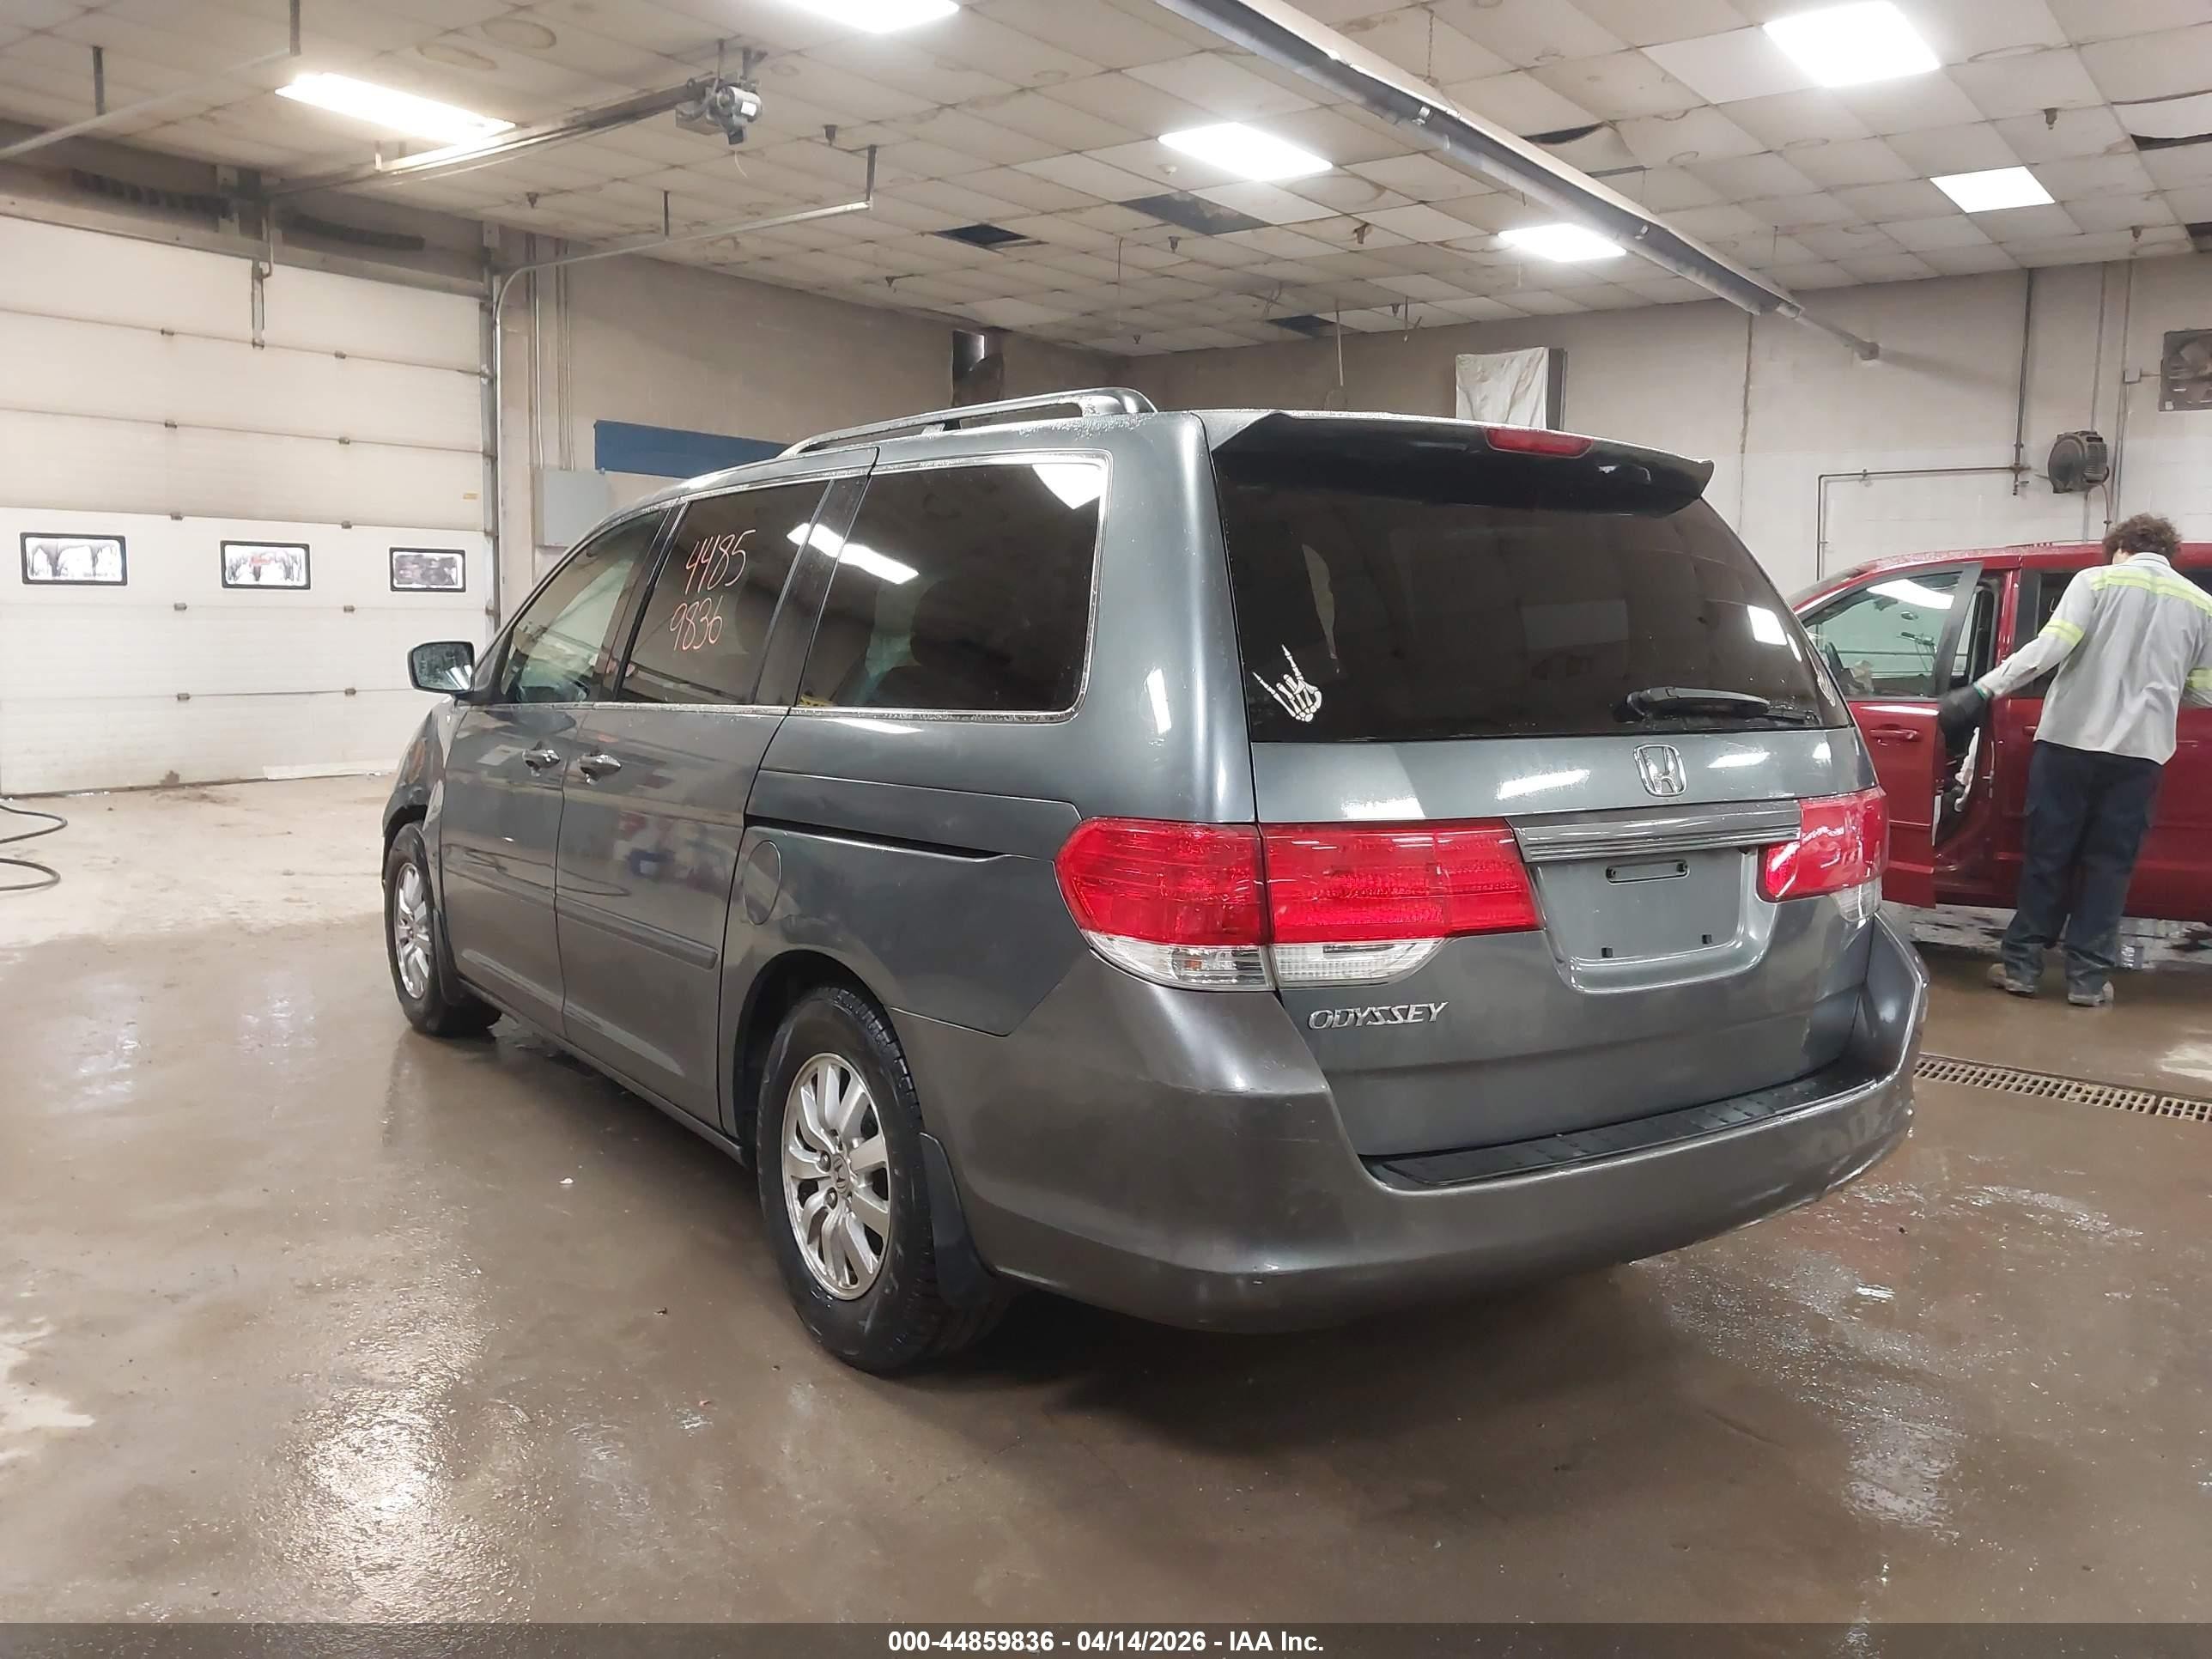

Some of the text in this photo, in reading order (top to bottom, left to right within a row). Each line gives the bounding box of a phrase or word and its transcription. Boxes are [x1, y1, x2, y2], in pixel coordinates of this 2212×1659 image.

[685, 529, 757, 595] 4485
[669, 595, 723, 651] 9836
[1308, 1001, 1449, 1030] ODYSSEY
